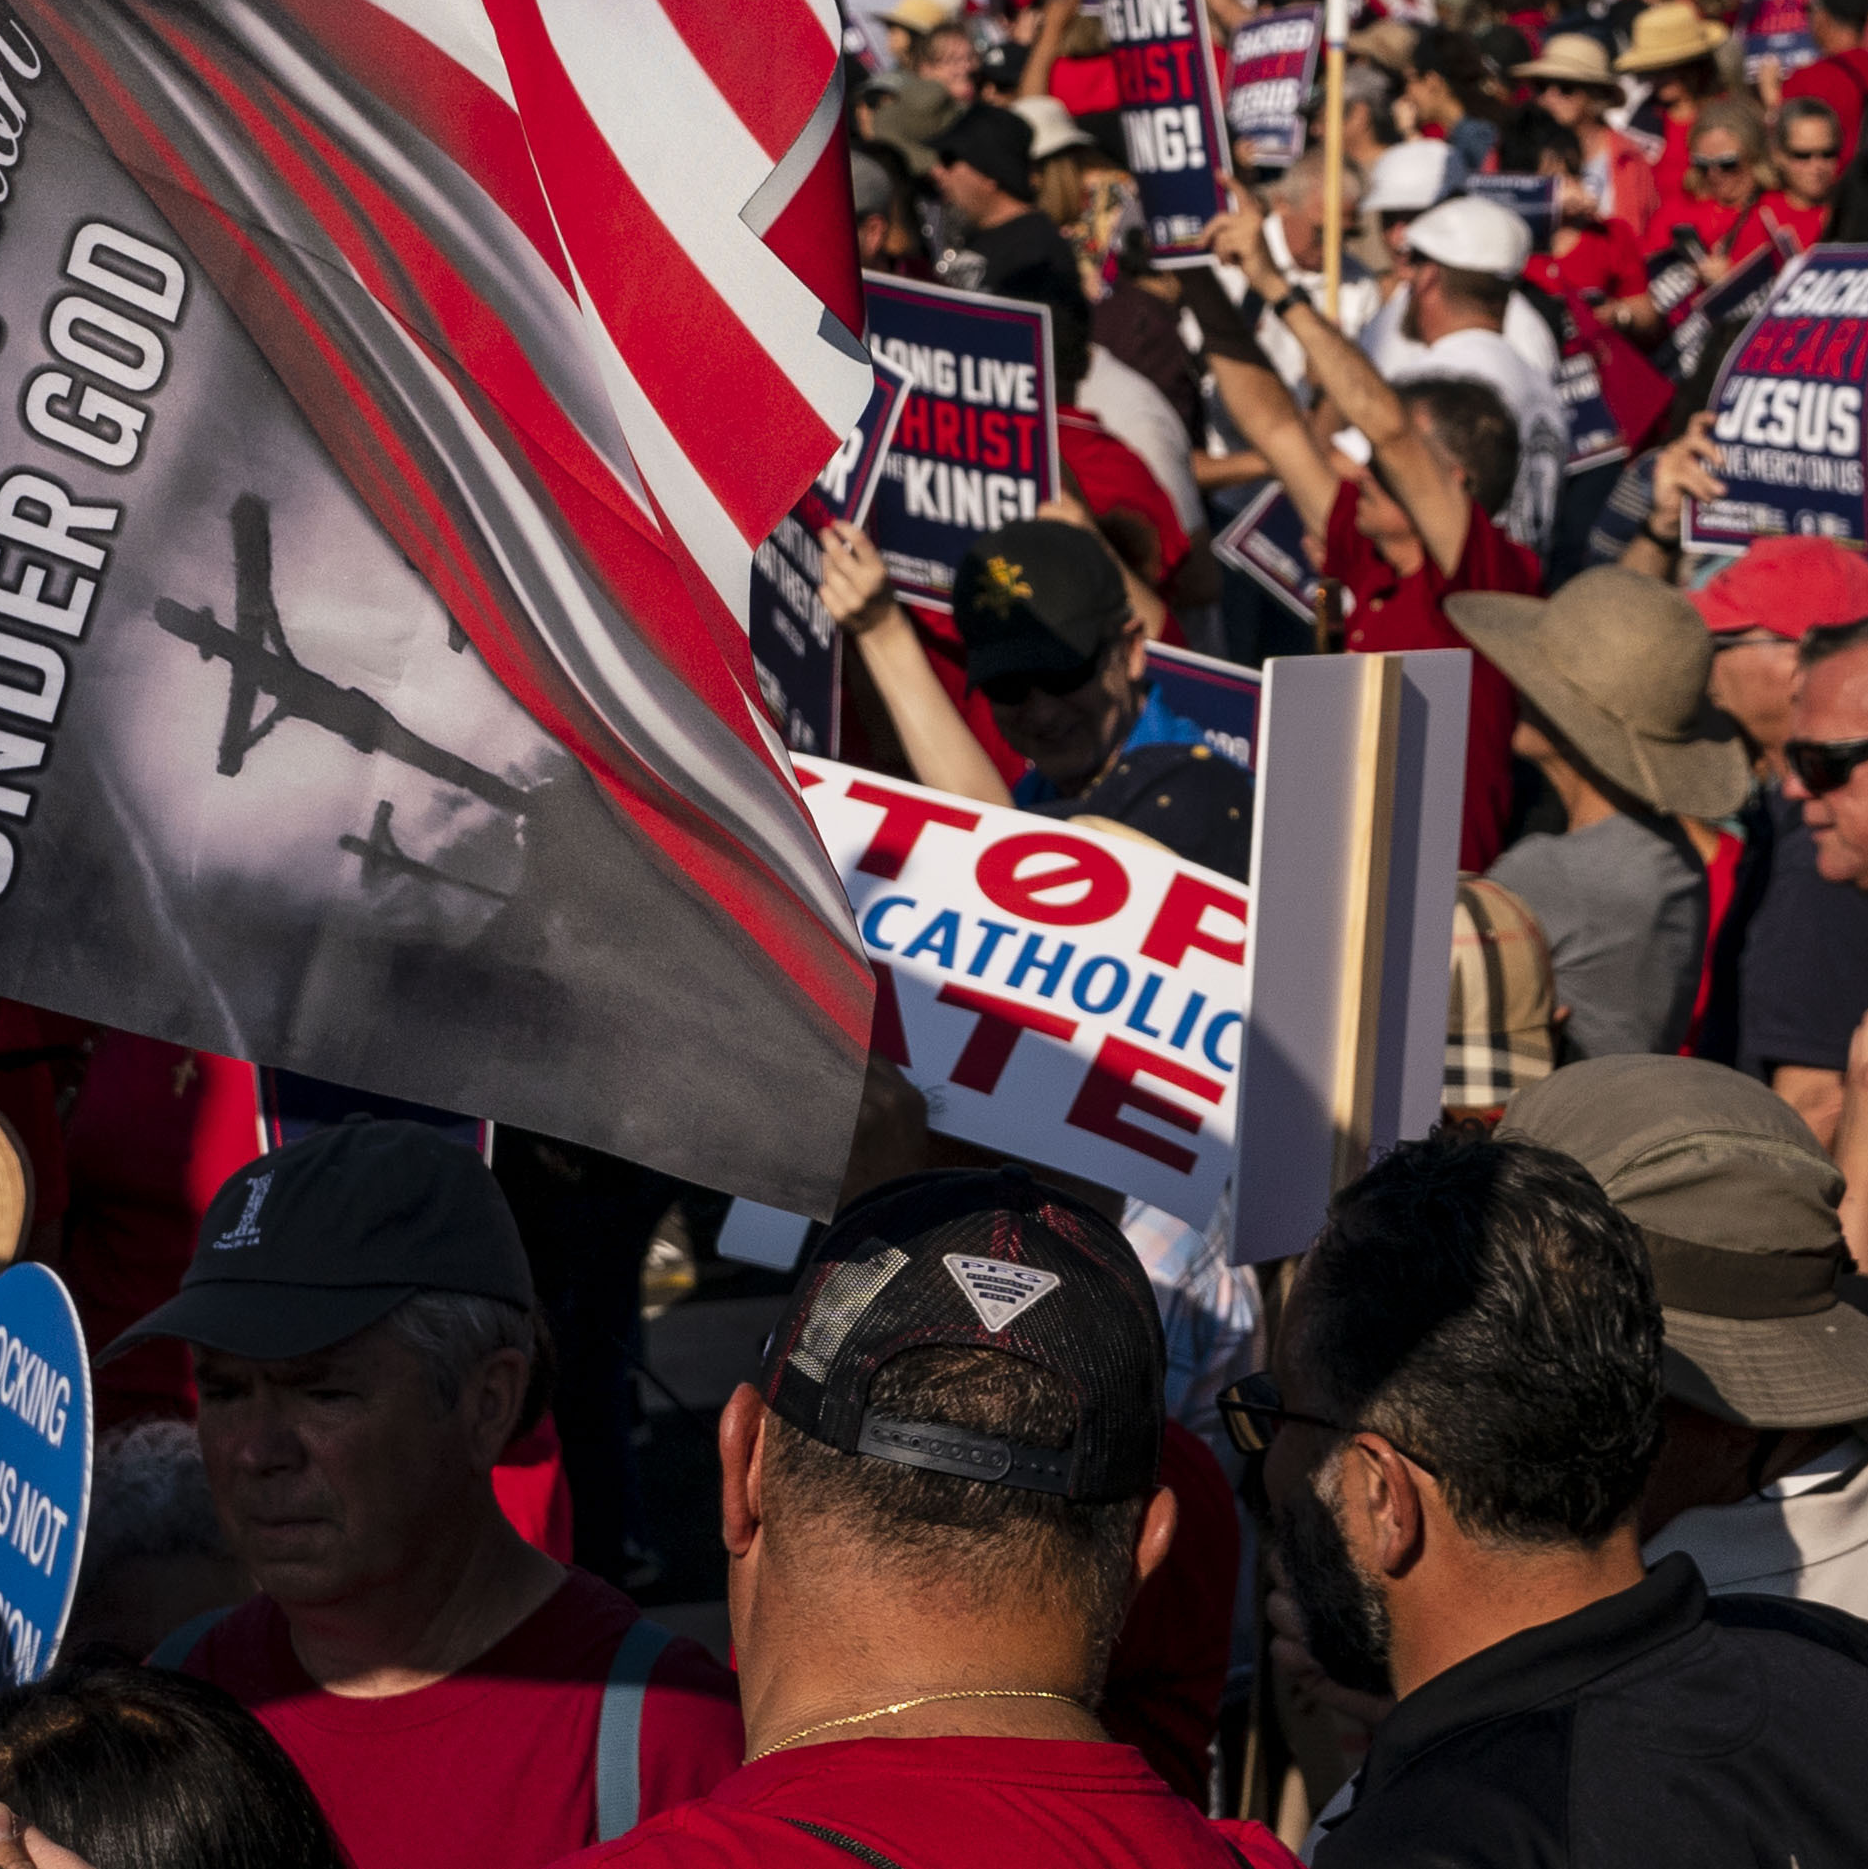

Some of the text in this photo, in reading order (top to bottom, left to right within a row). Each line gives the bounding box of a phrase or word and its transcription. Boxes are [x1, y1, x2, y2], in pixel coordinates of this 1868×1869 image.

[24, 222, 187, 468] GOD
[870, 333, 1040, 412] LONG LIVE
[1714, 378, 1863, 458] JESUS
[791, 753, 1248, 968] TOP
[874, 959, 1227, 1173] TE
[961, 1261, 1042, 1284] PFG
[11, 1480, 69, 1578] NOT
